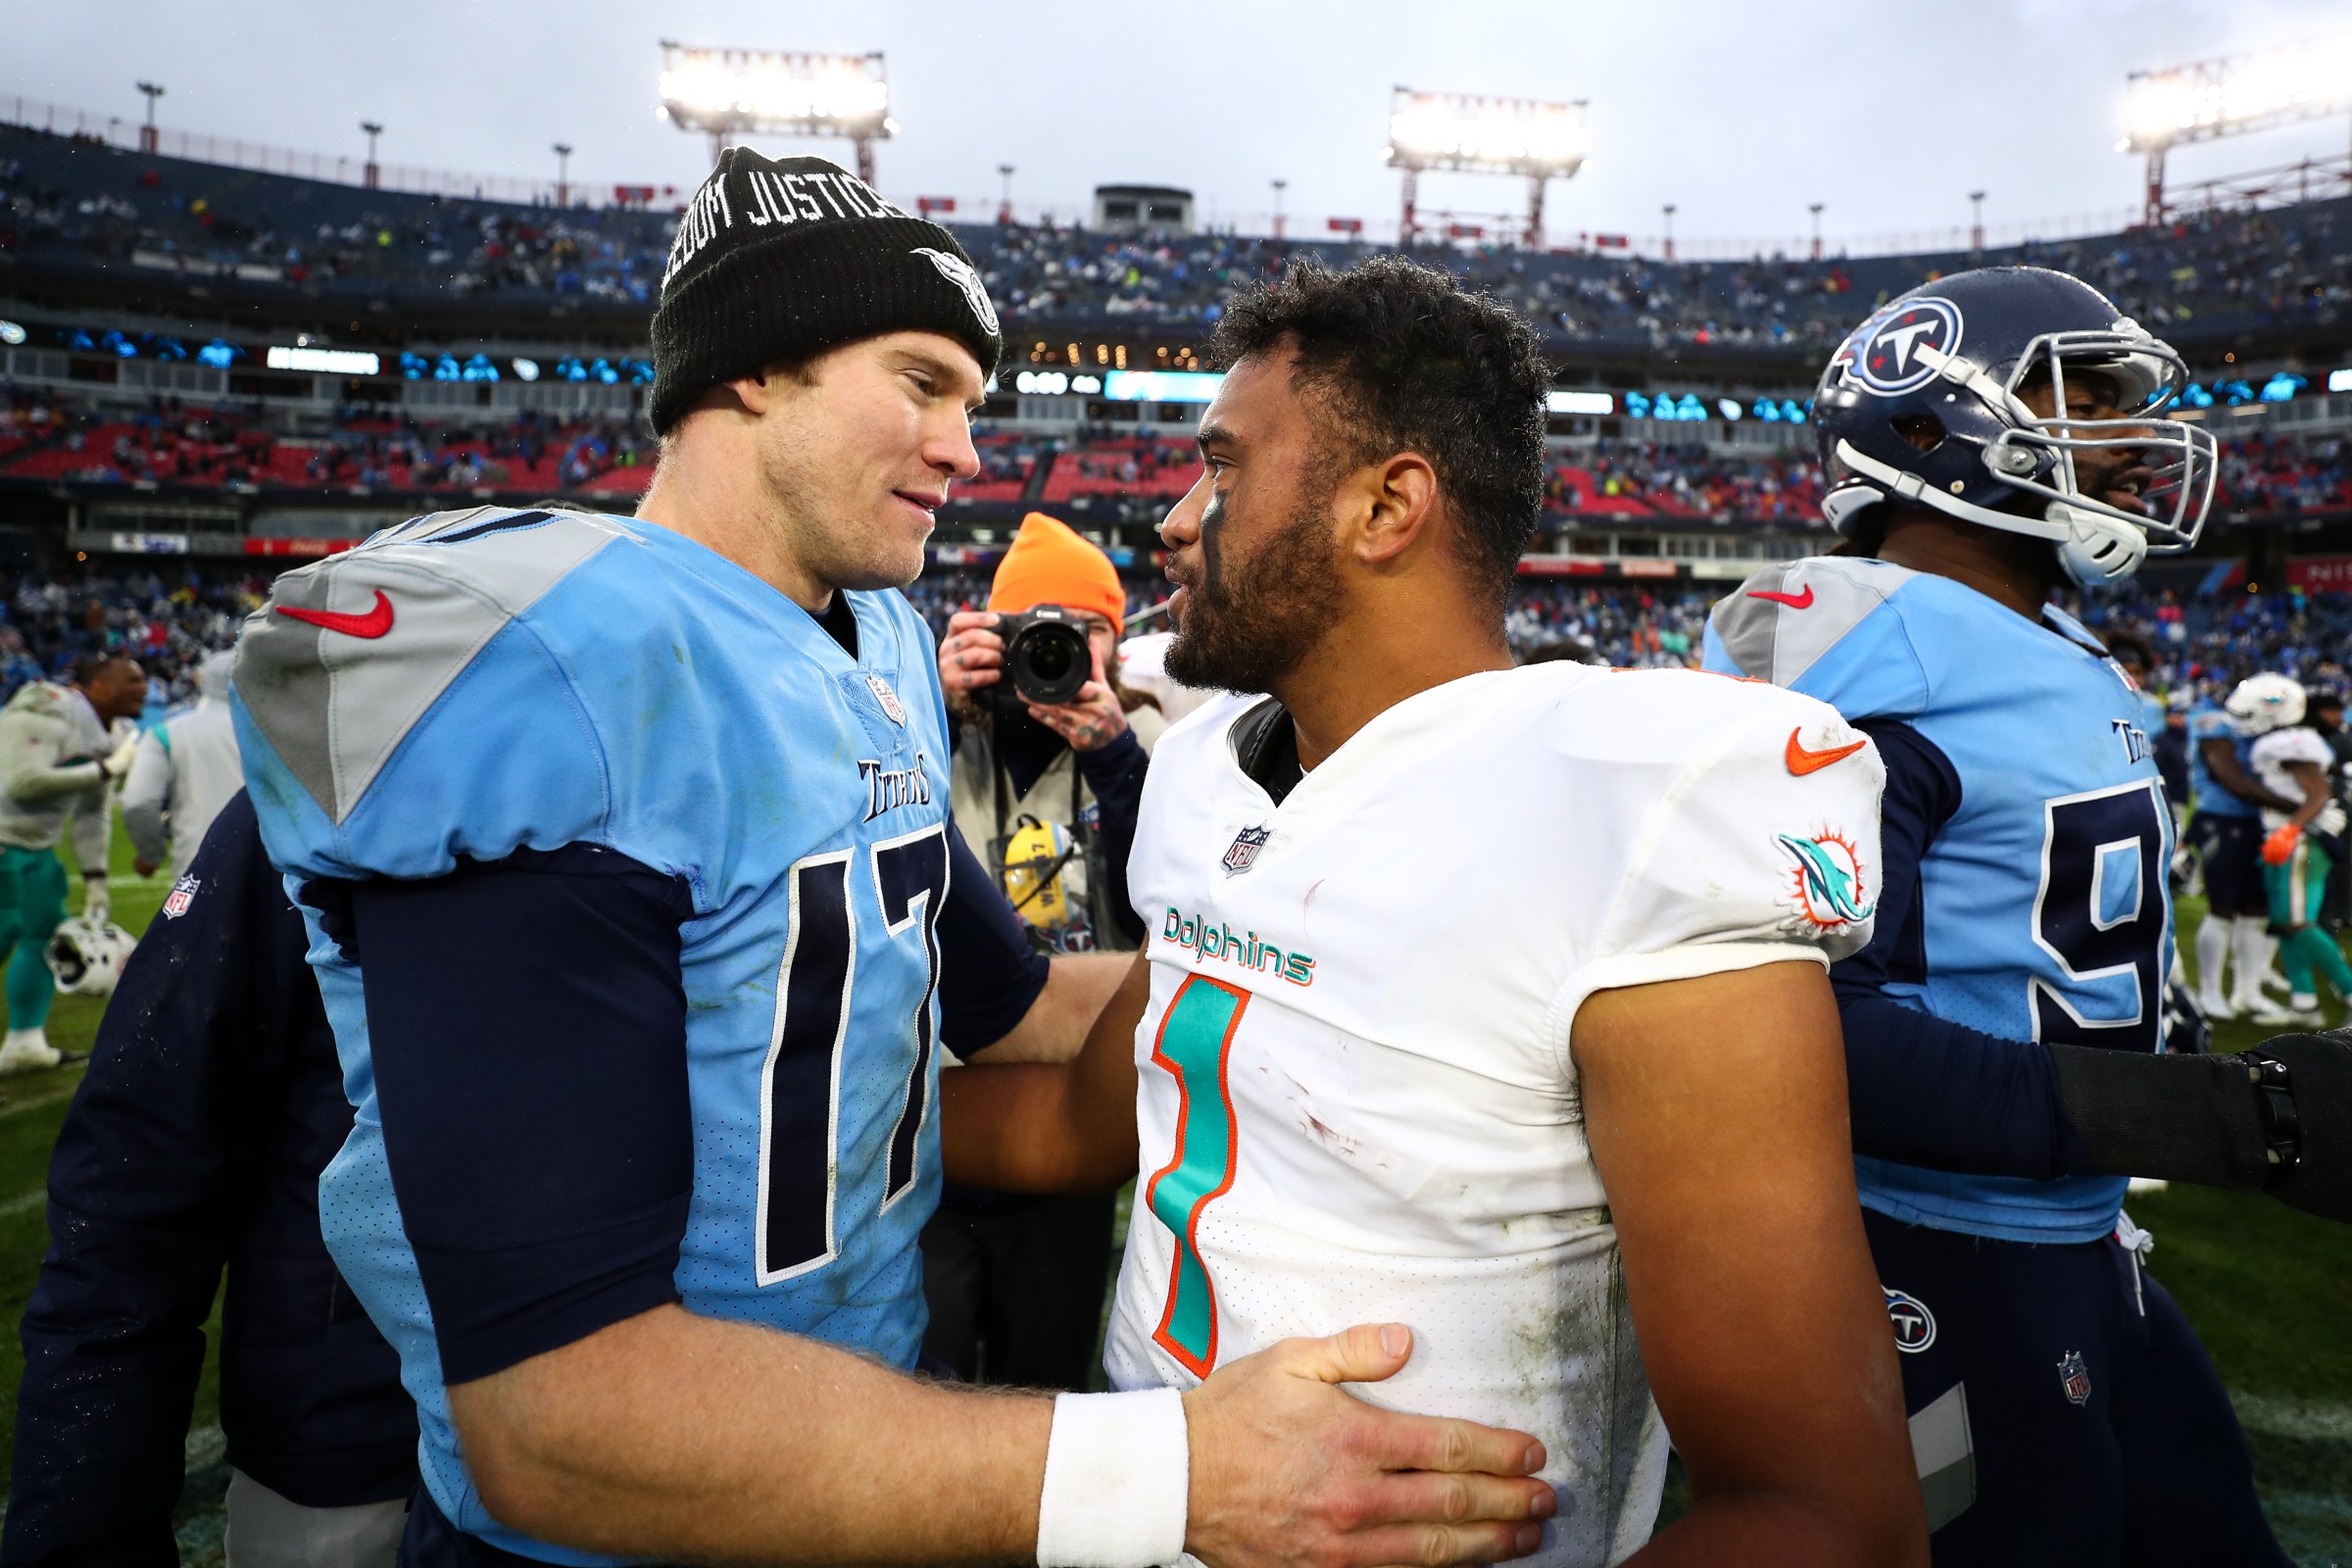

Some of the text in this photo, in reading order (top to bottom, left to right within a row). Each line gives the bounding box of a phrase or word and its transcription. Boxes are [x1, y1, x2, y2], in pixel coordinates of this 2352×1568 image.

[1226, 843, 1255, 866] NFL
[166, 892, 190, 912] NFL
[1163, 906, 1316, 987] Dolphins
[755, 821, 951, 1288] 17
[1146, 972, 1252, 1381] 1
